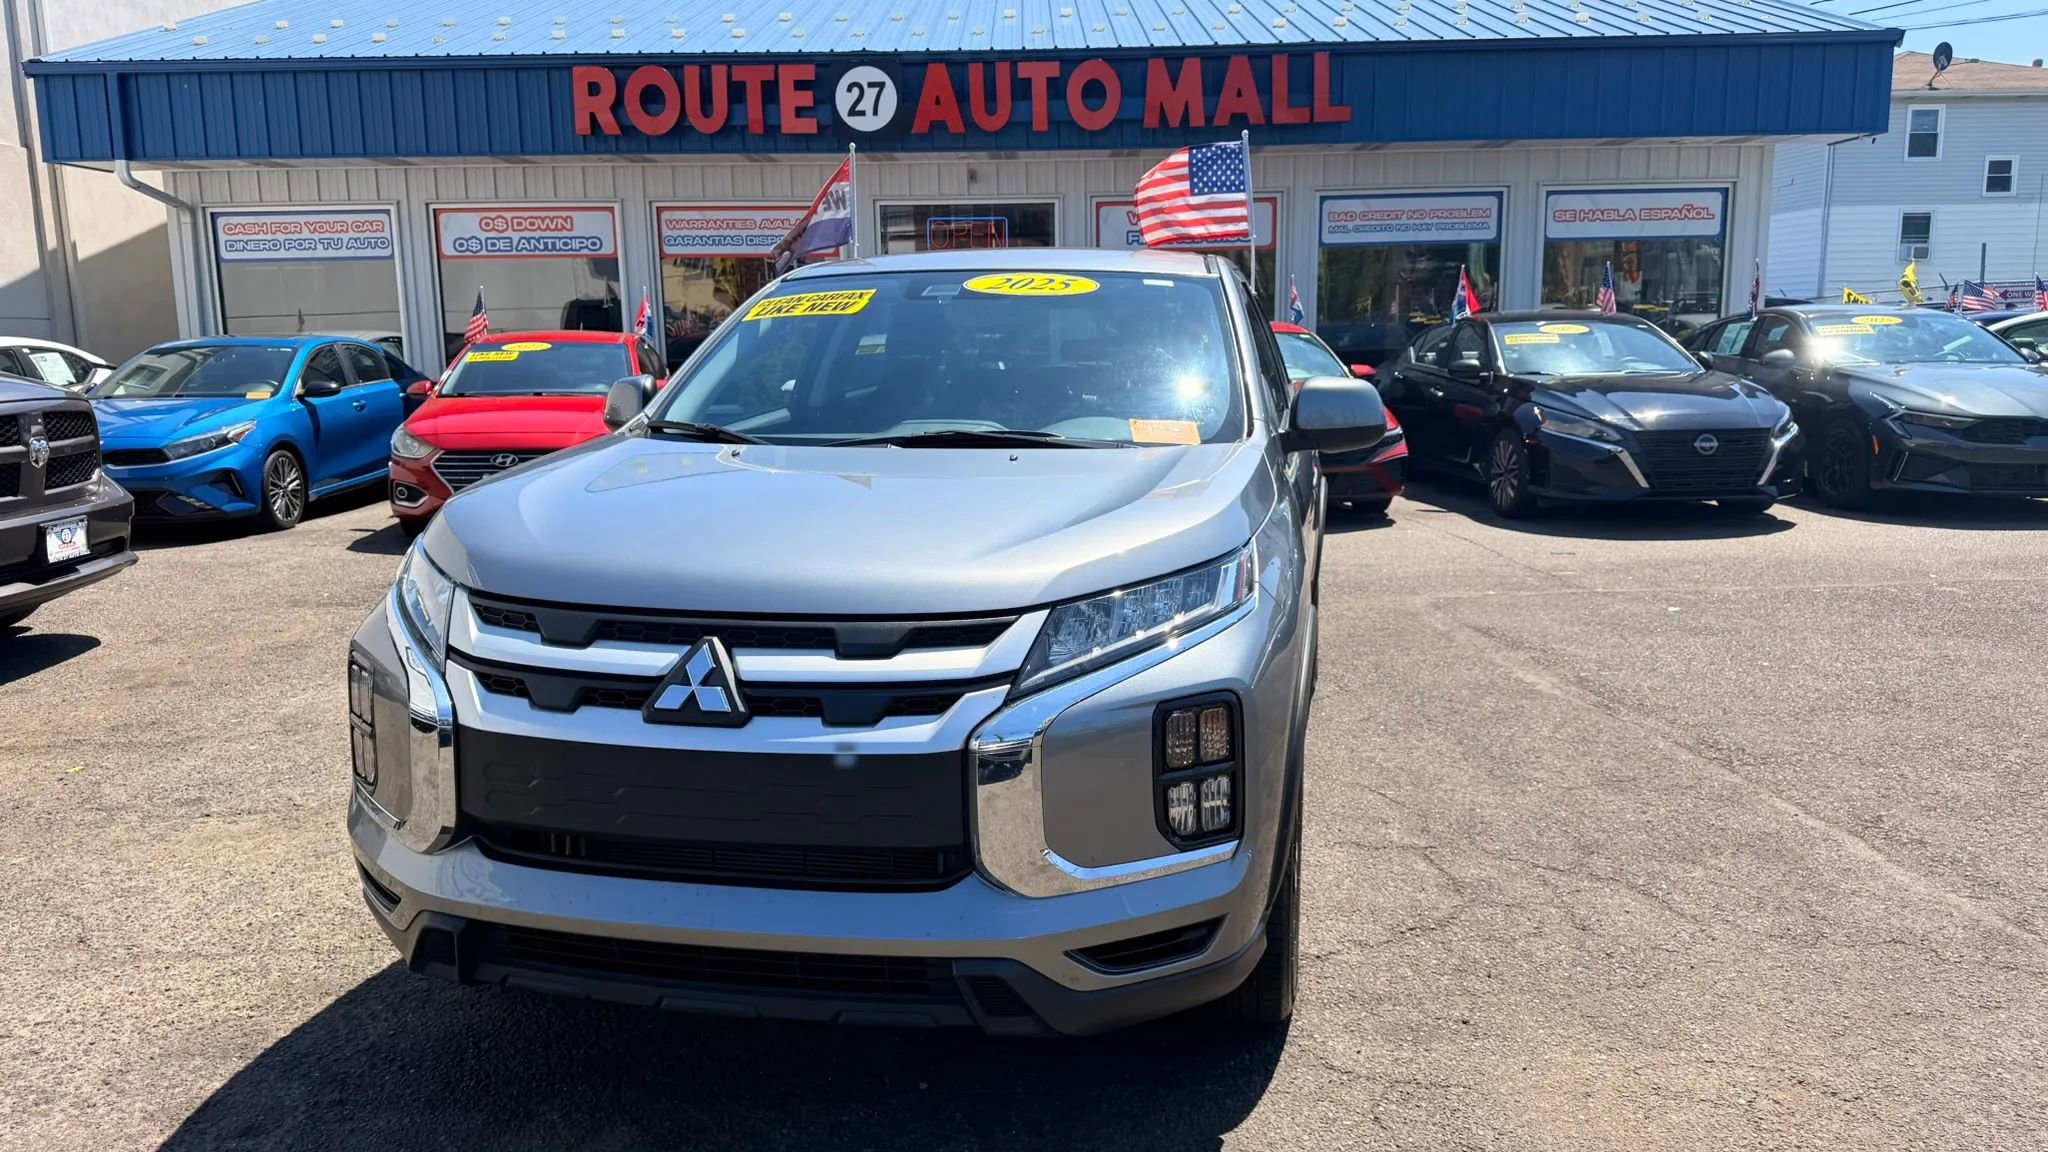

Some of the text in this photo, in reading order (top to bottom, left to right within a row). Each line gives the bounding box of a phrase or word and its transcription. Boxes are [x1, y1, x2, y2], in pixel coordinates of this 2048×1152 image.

[572, 51, 1352, 136] ROUTE 27 AUTO MALL
[1327, 208, 1492, 223] BAD CREDIT NO PROBLEM
[1553, 204, 1715, 223] SE HABLA ESPAÑOL
[223, 220, 384, 235] CASH FOR YOUR CAR
[511, 216, 573, 232] DOWN
[665, 218, 757, 230] WARRANTIES
[1328, 222, 1490, 234] MAL CREDITO NO HAY PROBLEMA
[664, 234, 744, 248] GARANTIAS
[931, 221, 1005, 249] OPEN
[225, 237, 390, 251] DINERO POR TU AUTO
[485, 237, 513, 252] DE
[515, 236, 602, 251] ANTICIPO
[984, 278, 1079, 291] 2025
[804, 291, 866, 303] CARFAX
[754, 300, 860, 316] LIKE NEW
